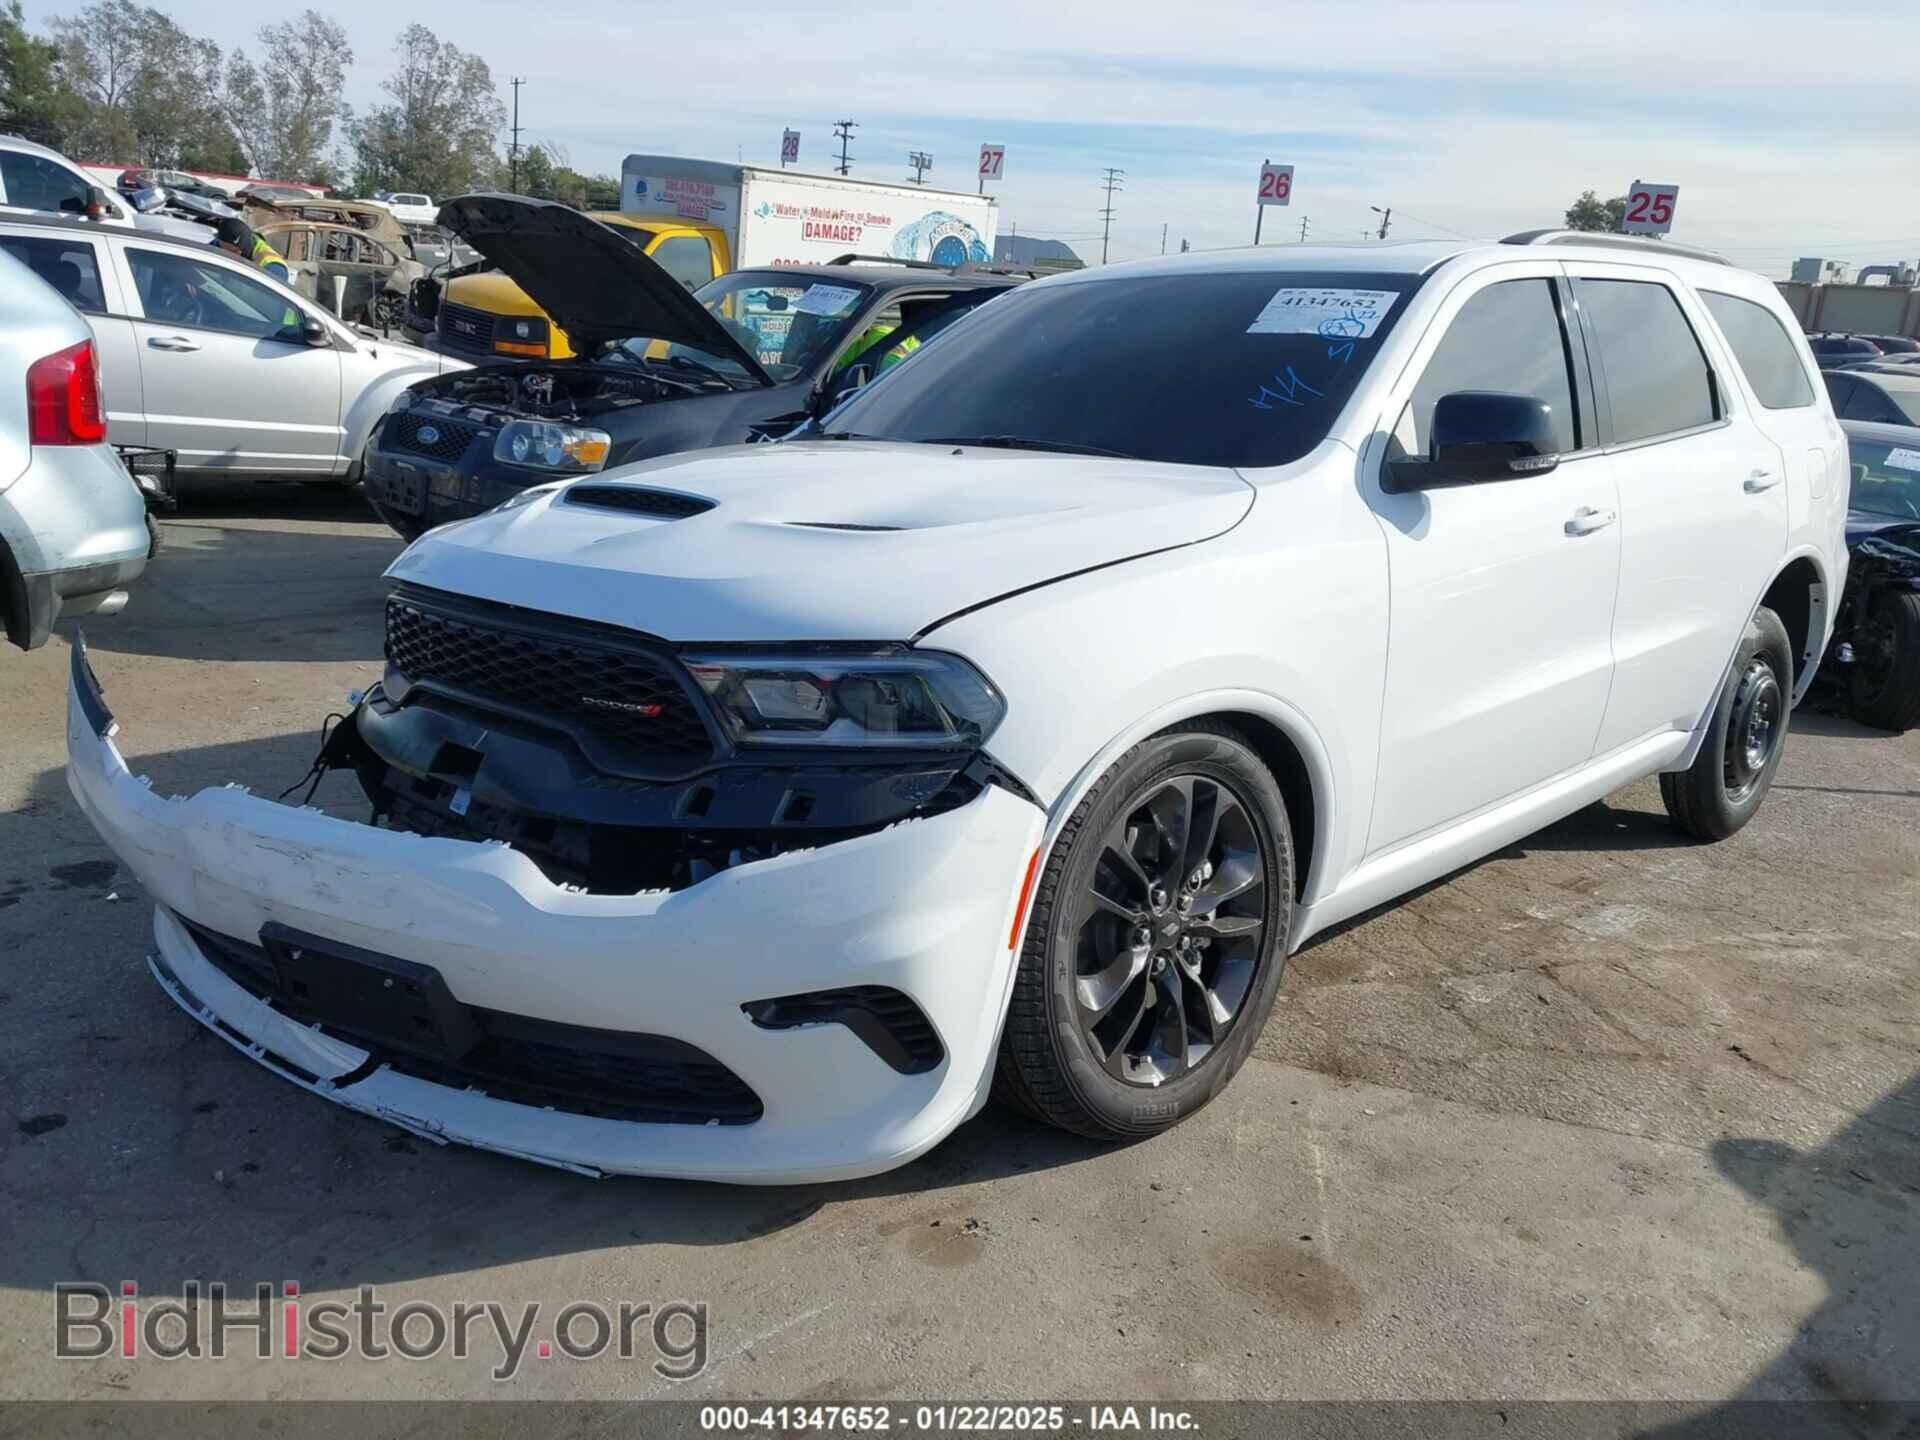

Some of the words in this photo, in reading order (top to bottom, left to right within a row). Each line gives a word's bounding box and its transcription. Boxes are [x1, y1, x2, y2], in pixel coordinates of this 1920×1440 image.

[783, 136, 799, 157] 28
[980, 151, 1004, 174] 27
[1259, 171, 1290, 199] 26
[775, 203, 800, 217] Water
[810, 207, 832, 220] Mold
[840, 209, 855, 222] Fire
[866, 212, 892, 225] Smoke
[1626, 191, 1674, 225] 25
[805, 222, 863, 241] DAMAGE?
[581, 696, 649, 714] DODGE
